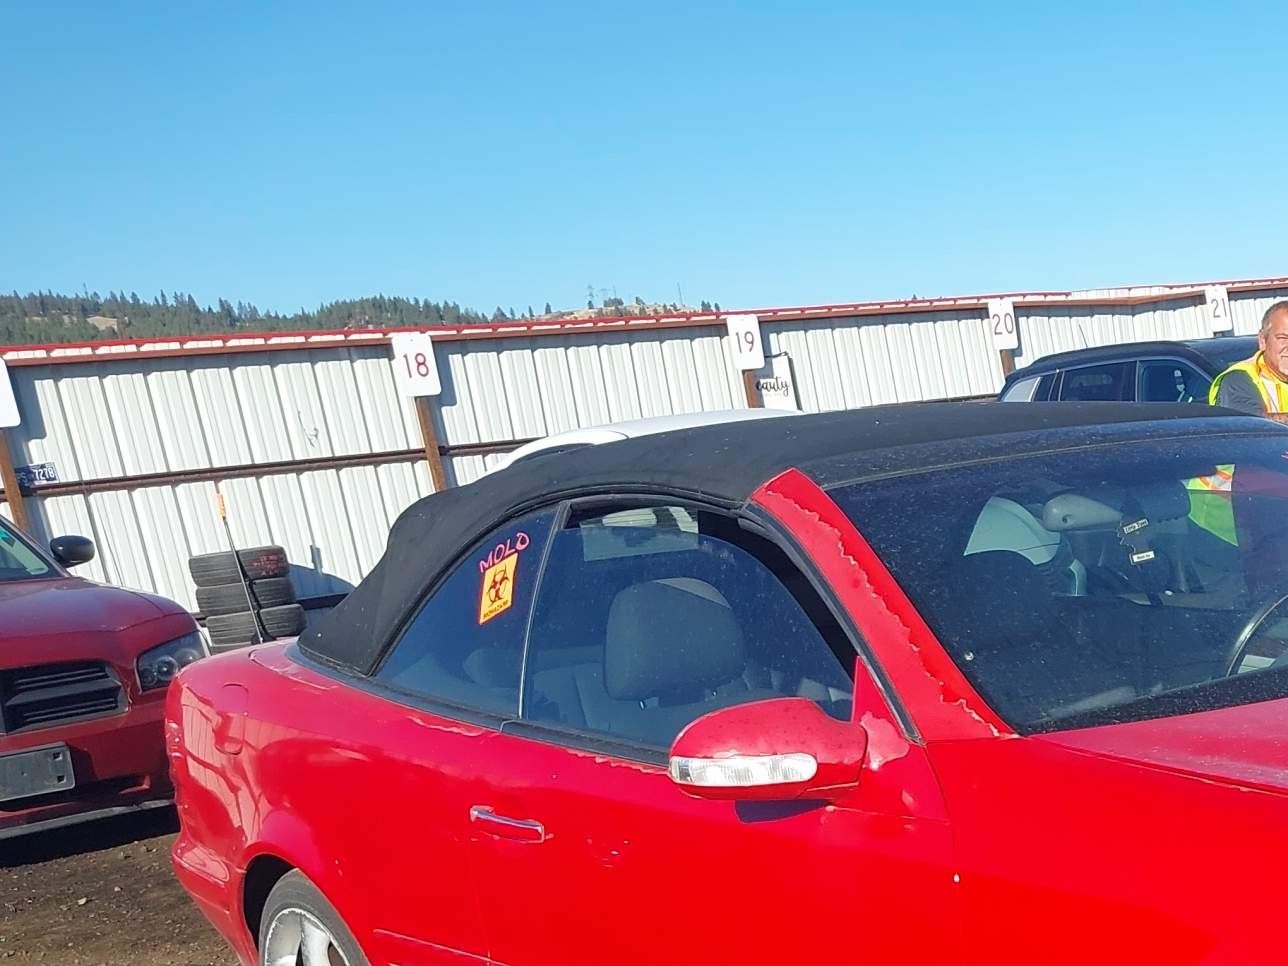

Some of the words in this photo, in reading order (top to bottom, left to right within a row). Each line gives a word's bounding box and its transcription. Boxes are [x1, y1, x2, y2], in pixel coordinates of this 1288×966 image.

[1210, 297, 1227, 318] 21
[992, 312, 1014, 335] 20
[735, 330, 755, 354] 19
[402, 352, 430, 379] 18
[479, 531, 530, 574] MOLD
